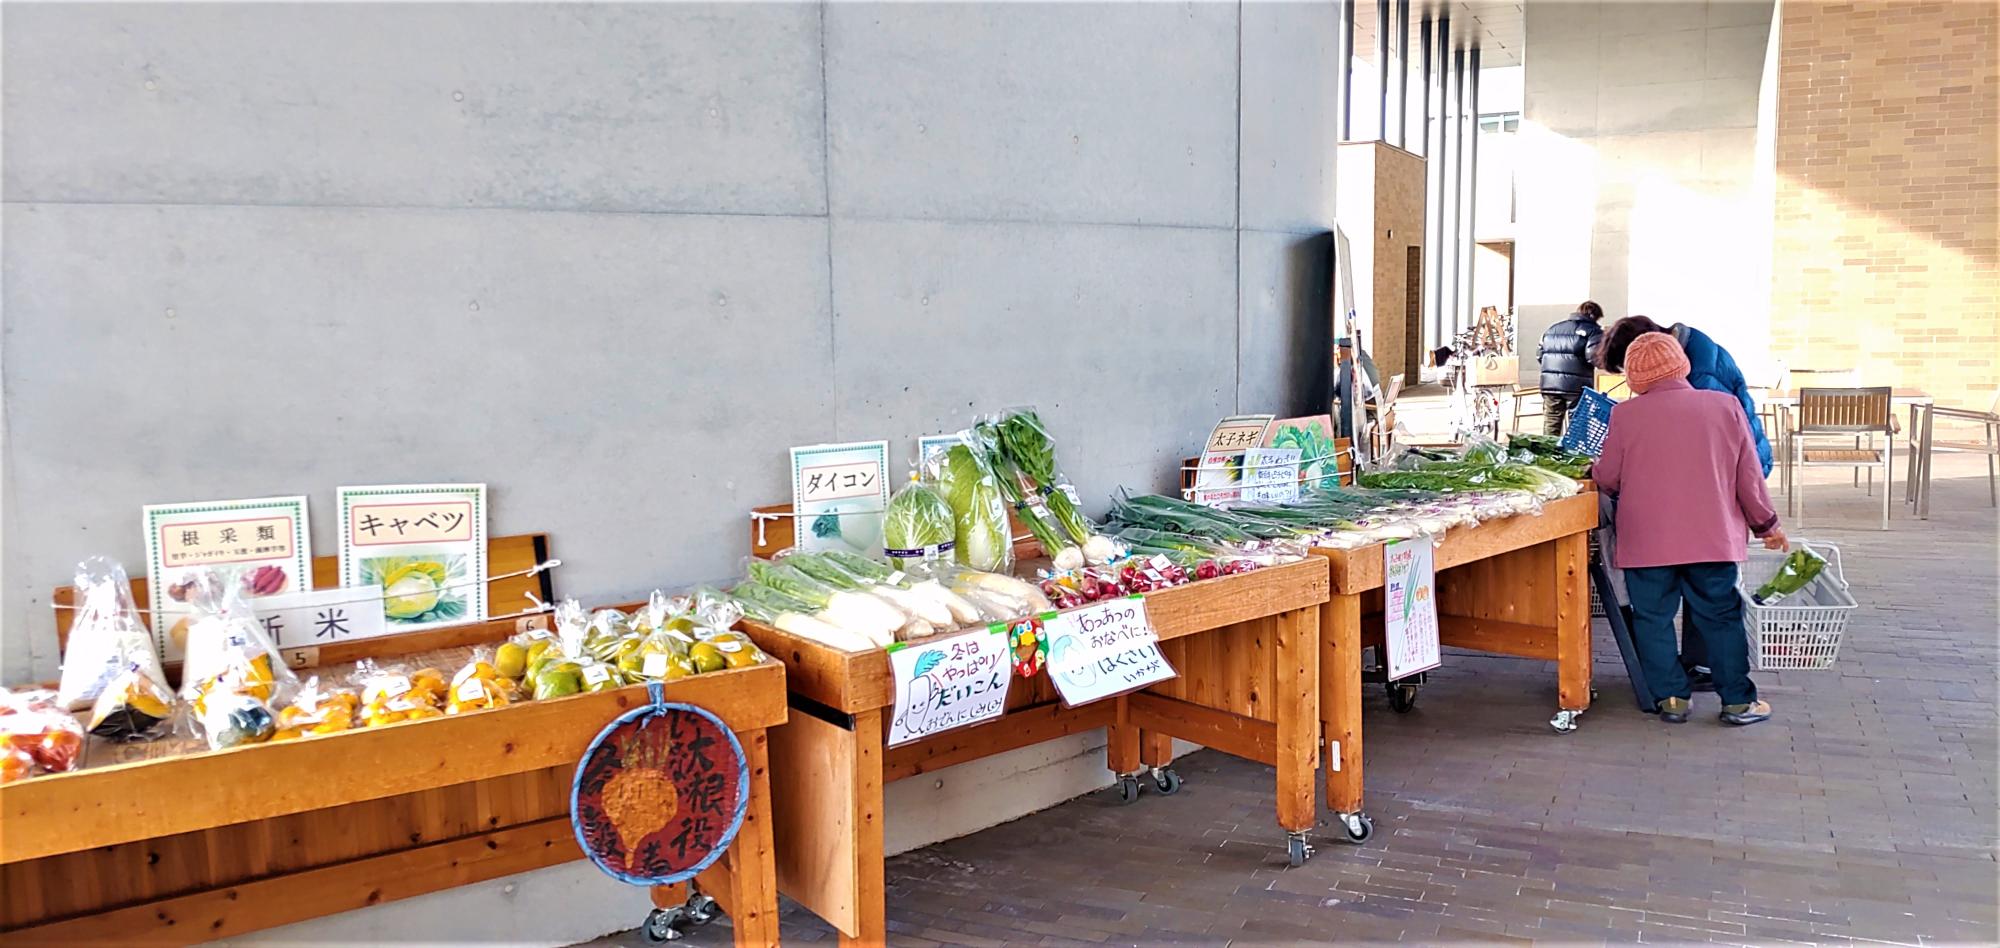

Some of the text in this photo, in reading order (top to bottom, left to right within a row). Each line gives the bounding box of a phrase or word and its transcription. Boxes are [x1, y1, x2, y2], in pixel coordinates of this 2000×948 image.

[1214, 431, 1259, 448] 太子ネギ
[806, 471, 876, 495] ダイコン
[358, 511, 464, 537] キャベツ
[525, 619, 535, 631] 6
[295, 652, 306, 666] 5
[951, 641, 980, 661] 冬は
[1097, 645, 1156, 674] はくさい
[1123, 660, 1161, 683] いかが
[935, 673, 1004, 711] だいこん
